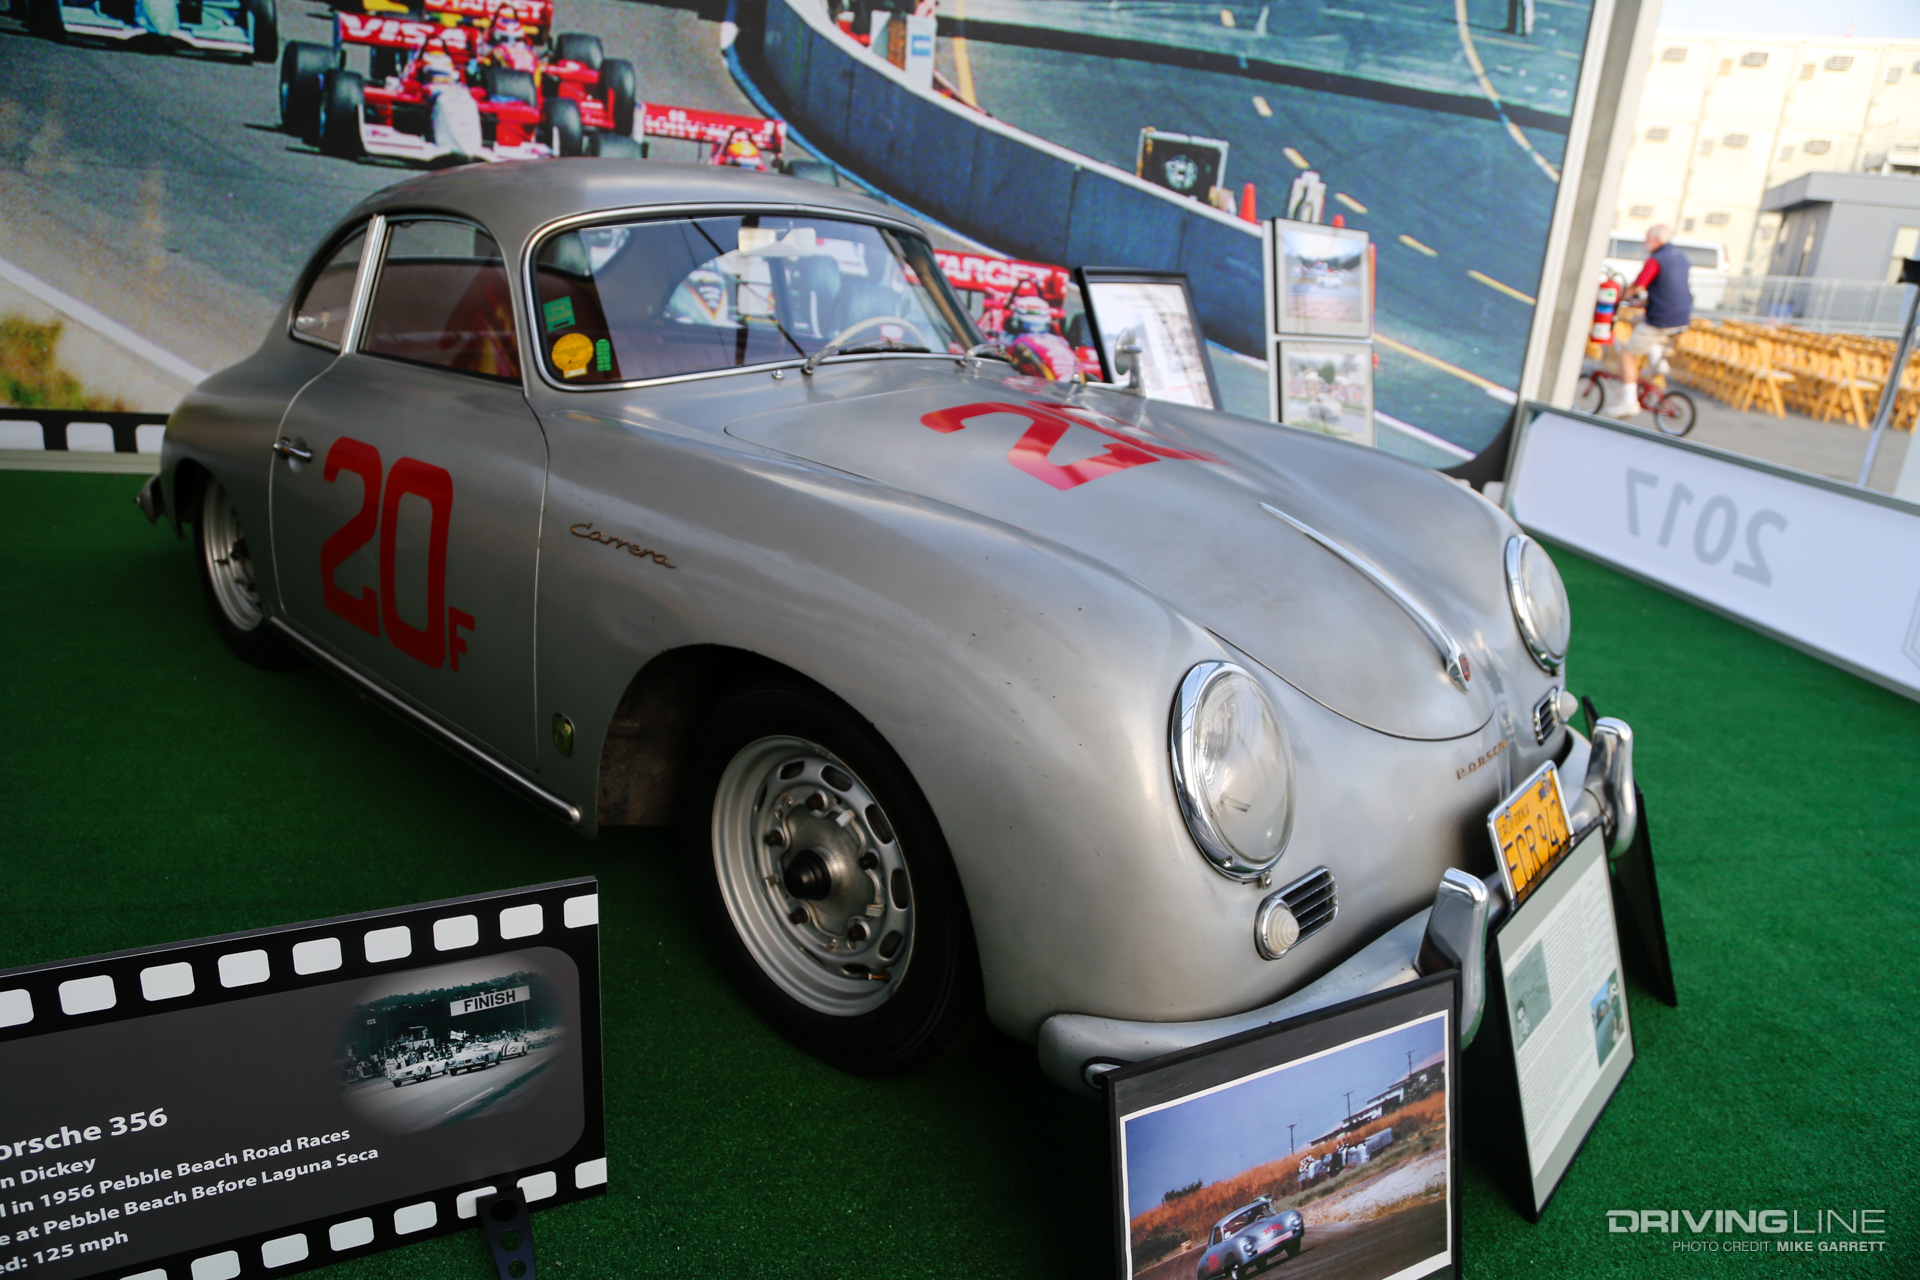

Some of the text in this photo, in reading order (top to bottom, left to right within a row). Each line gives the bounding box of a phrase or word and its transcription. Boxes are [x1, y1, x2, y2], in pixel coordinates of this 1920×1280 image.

[338, 12, 467, 49] VISA
[570, 522, 677, 569] Carrera
[464, 989, 516, 1013] FINISH
[109, 1107, 168, 1136] 356
[12, 1200, 34, 1215] in
[40, 1184, 95, 1207] 1956
[100, 1168, 173, 1194] Pebble
[177, 1152, 238, 1177] Beach
[242, 1139, 292, 1162] Road
[297, 1130, 350, 1150] Races
[20, 1158, 96, 1185] Dickey
[16, 1225, 39, 1242] at
[44, 1207, 120, 1235] Pebble
[124, 1190, 187, 1216] Beach
[191, 1176, 257, 1200] Before
[261, 1160, 332, 1184] Laguna
[336, 1149, 379, 1167] Seca
[33, 1243, 74, 1264] 125
[79, 1230, 129, 1253] mph
